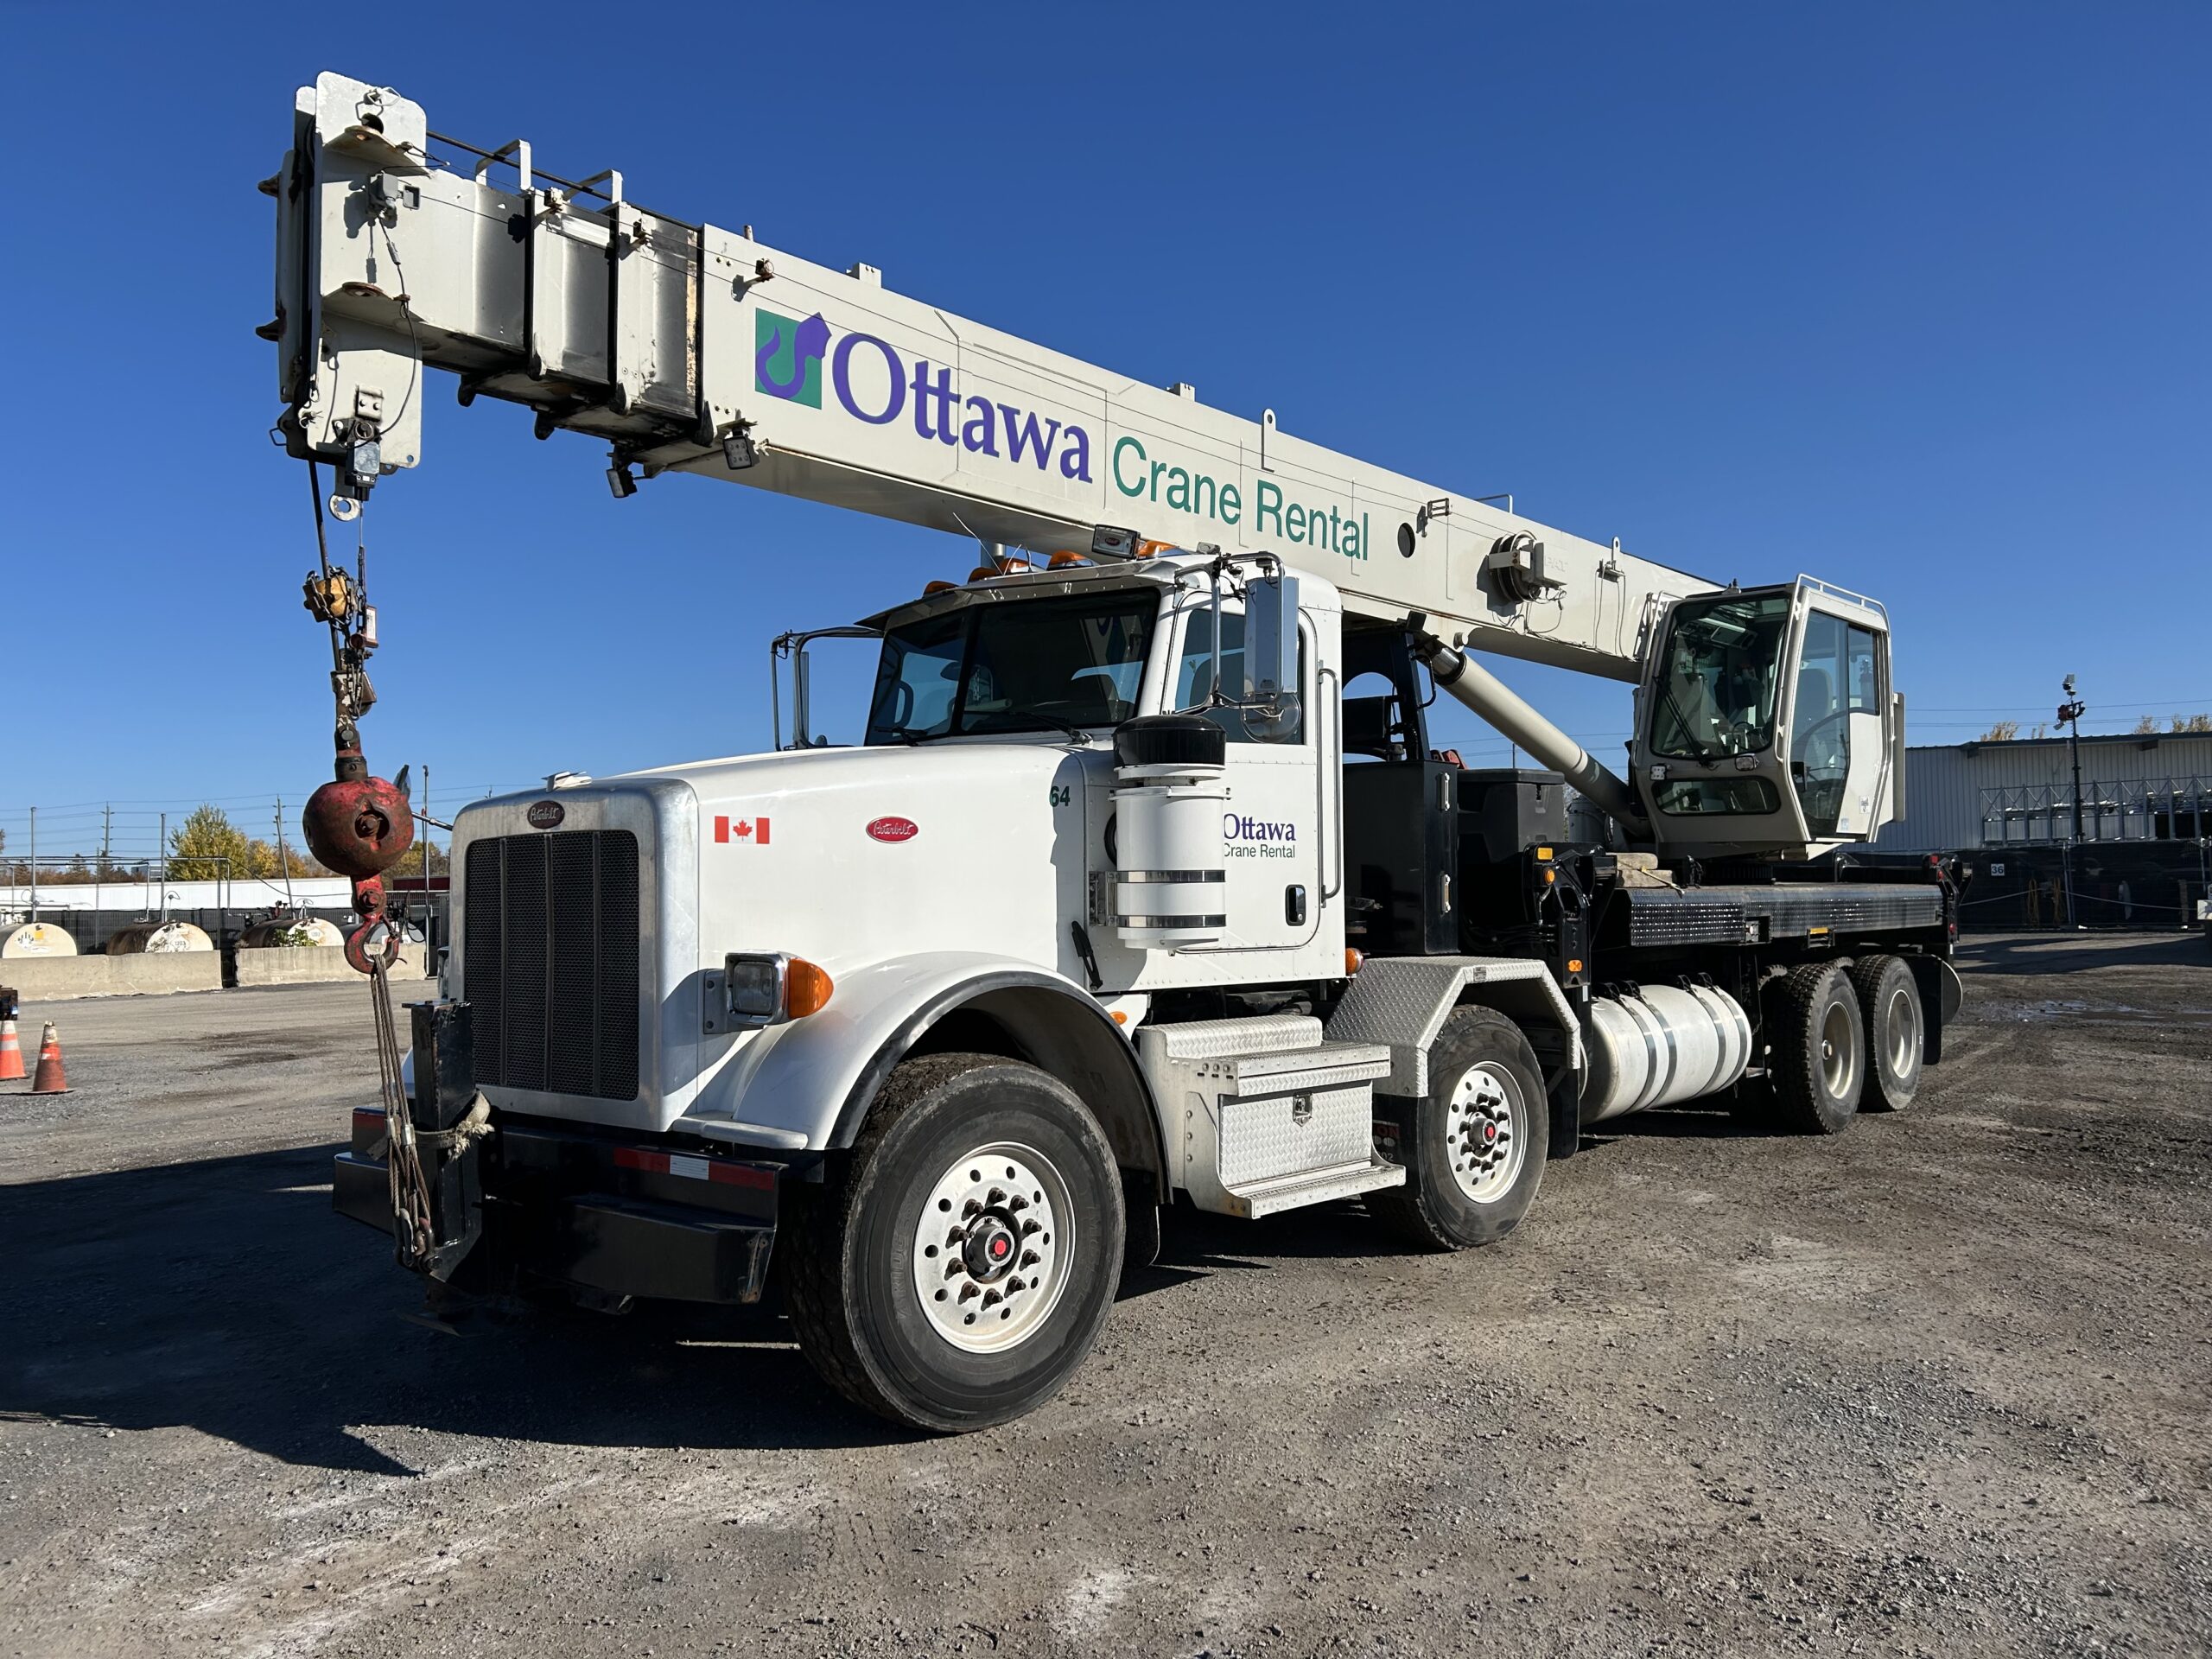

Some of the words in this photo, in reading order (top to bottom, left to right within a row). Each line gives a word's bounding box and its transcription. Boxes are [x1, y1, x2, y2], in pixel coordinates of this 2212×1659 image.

[832, 332, 1093, 484] Ottawa
[1113, 436, 1242, 524] Crane
[1256, 480, 1368, 561] Rental
[1050, 785, 1071, 807] 64
[874, 820, 914, 836] Peterbilt
[1224, 813, 1296, 841] Ottawa
[1260, 843, 1295, 858] Rental
